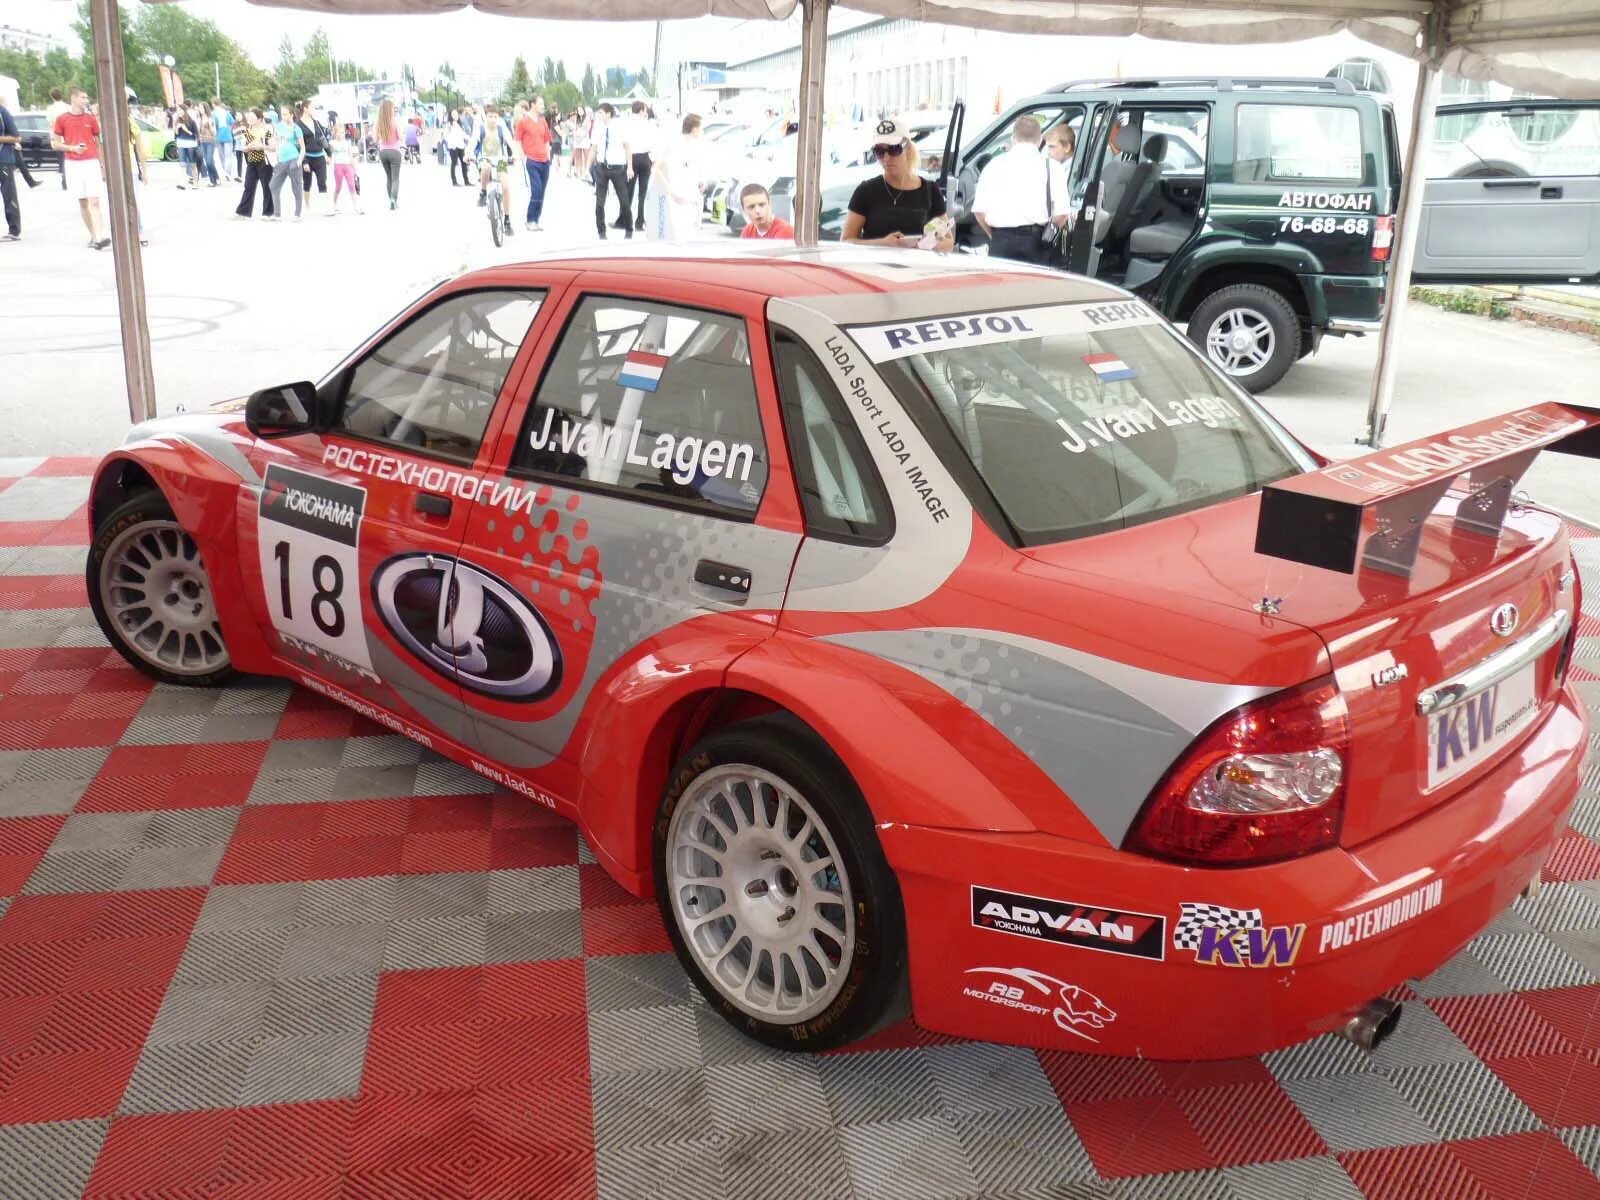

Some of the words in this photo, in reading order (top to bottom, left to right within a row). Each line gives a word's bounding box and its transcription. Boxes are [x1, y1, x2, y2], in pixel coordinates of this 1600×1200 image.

[1278, 191, 1372, 211] АВТОФАН
[1279, 216, 1369, 235] 76-68-68
[884, 315, 1033, 350] REPSOL
[529, 407, 624, 460] J.van
[626, 418, 754, 486] Lagen
[824, 336, 855, 377] LADA
[849, 376, 882, 420] Sport
[877, 420, 911, 465] LADA
[905, 466, 950, 524] IMAGE
[1056, 408, 1157, 454] J.van
[1140, 396, 1241, 429] Lagen
[322, 444, 537, 515] РОСТЕХНОЛОГИИ
[284, 487, 354, 529] YOKOHAMA
[274, 540, 345, 638] 18
[1436, 683, 1498, 772] KW
[471, 759, 556, 809] www.lada.ru
[978, 901, 1137, 942] ADVAN
[994, 918, 1042, 936] YOKOHAMA
[1319, 878, 1443, 954] РОСТЕХНОЛОГИИ
[1195, 923, 1307, 968] KW
[963, 987, 1051, 1015] MOTORSPORT
[988, 981, 1025, 1001] RB
